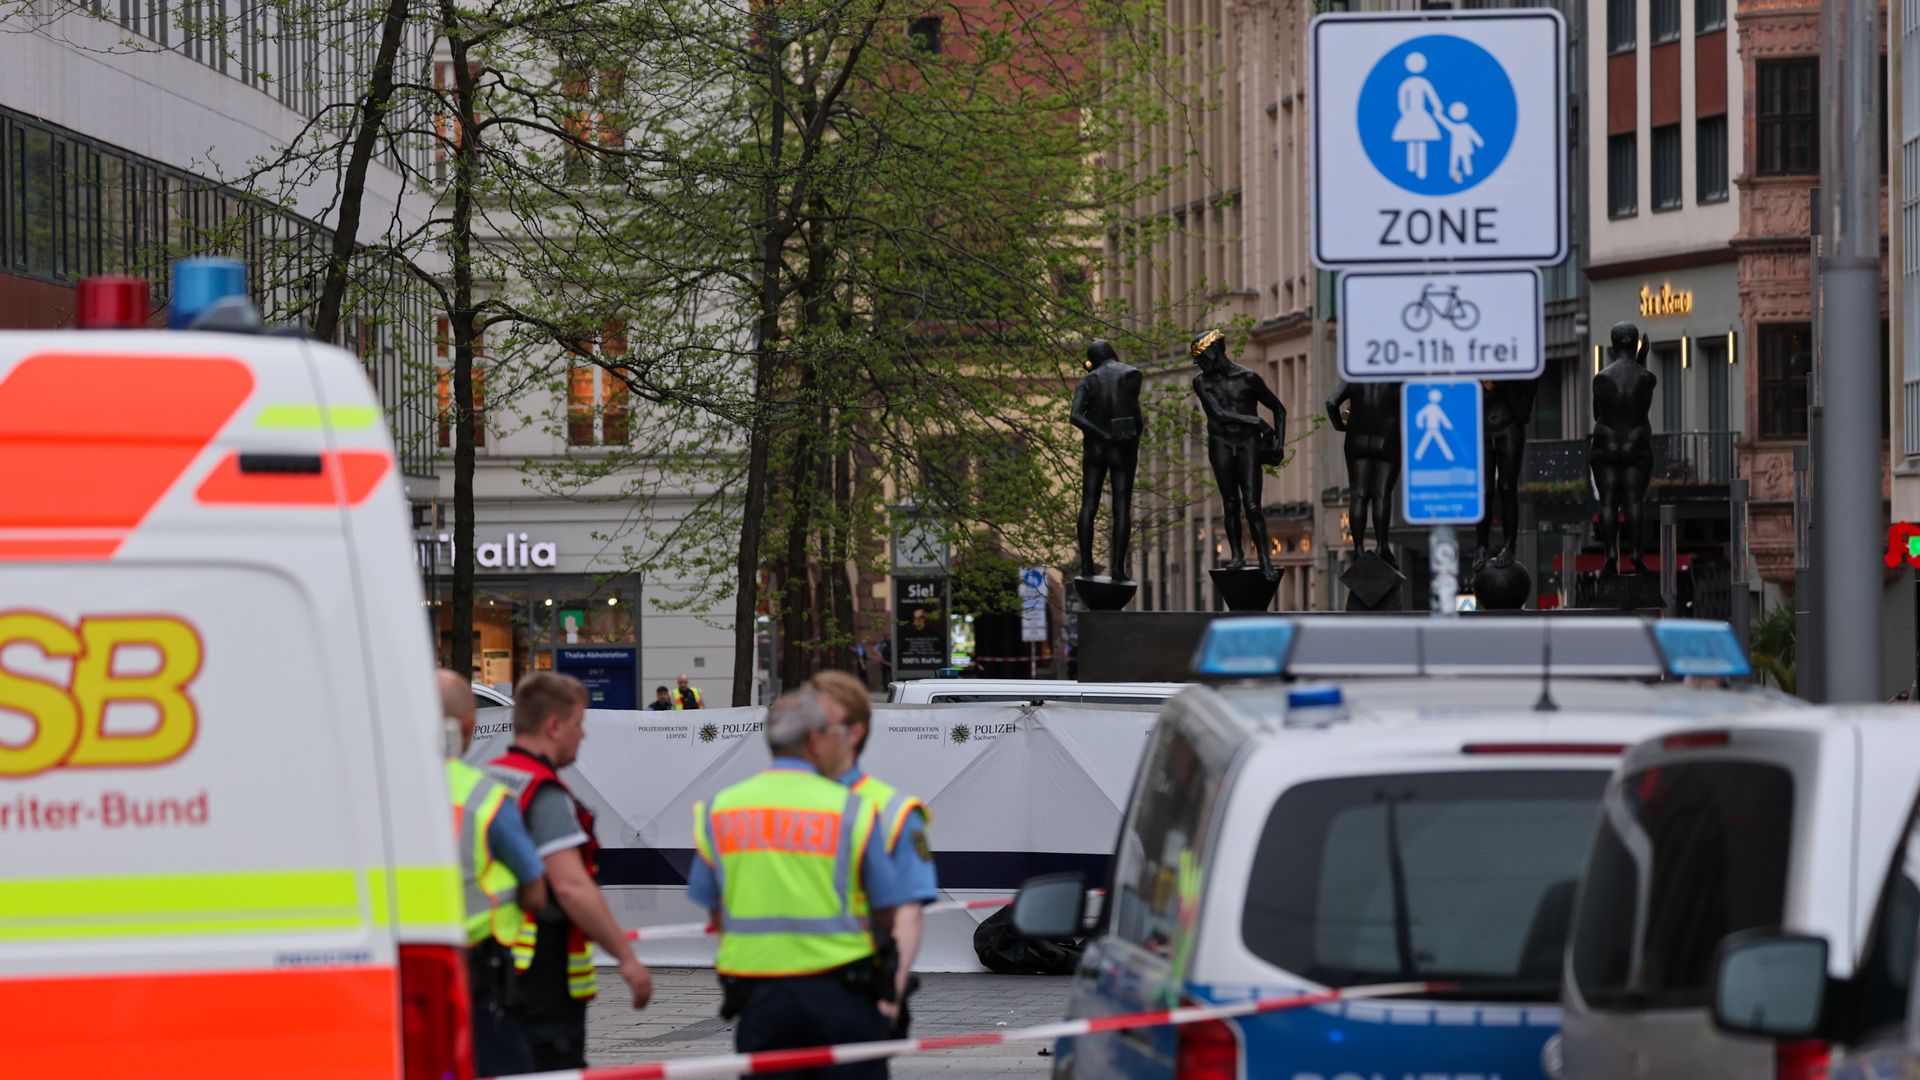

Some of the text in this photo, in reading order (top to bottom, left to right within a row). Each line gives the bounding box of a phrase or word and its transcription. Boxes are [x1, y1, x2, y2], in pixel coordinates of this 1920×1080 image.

[1379, 208, 1498, 245] ZONE
[1366, 336, 1518, 365] 20-11h frei
[907, 584, 935, 597] Sie!
[474, 723, 512, 735] POLIZEI
[722, 722, 763, 733] POLIZEI
[974, 723, 1016, 734] POLIZEI
[718, 811, 832, 852] POLIZEI
